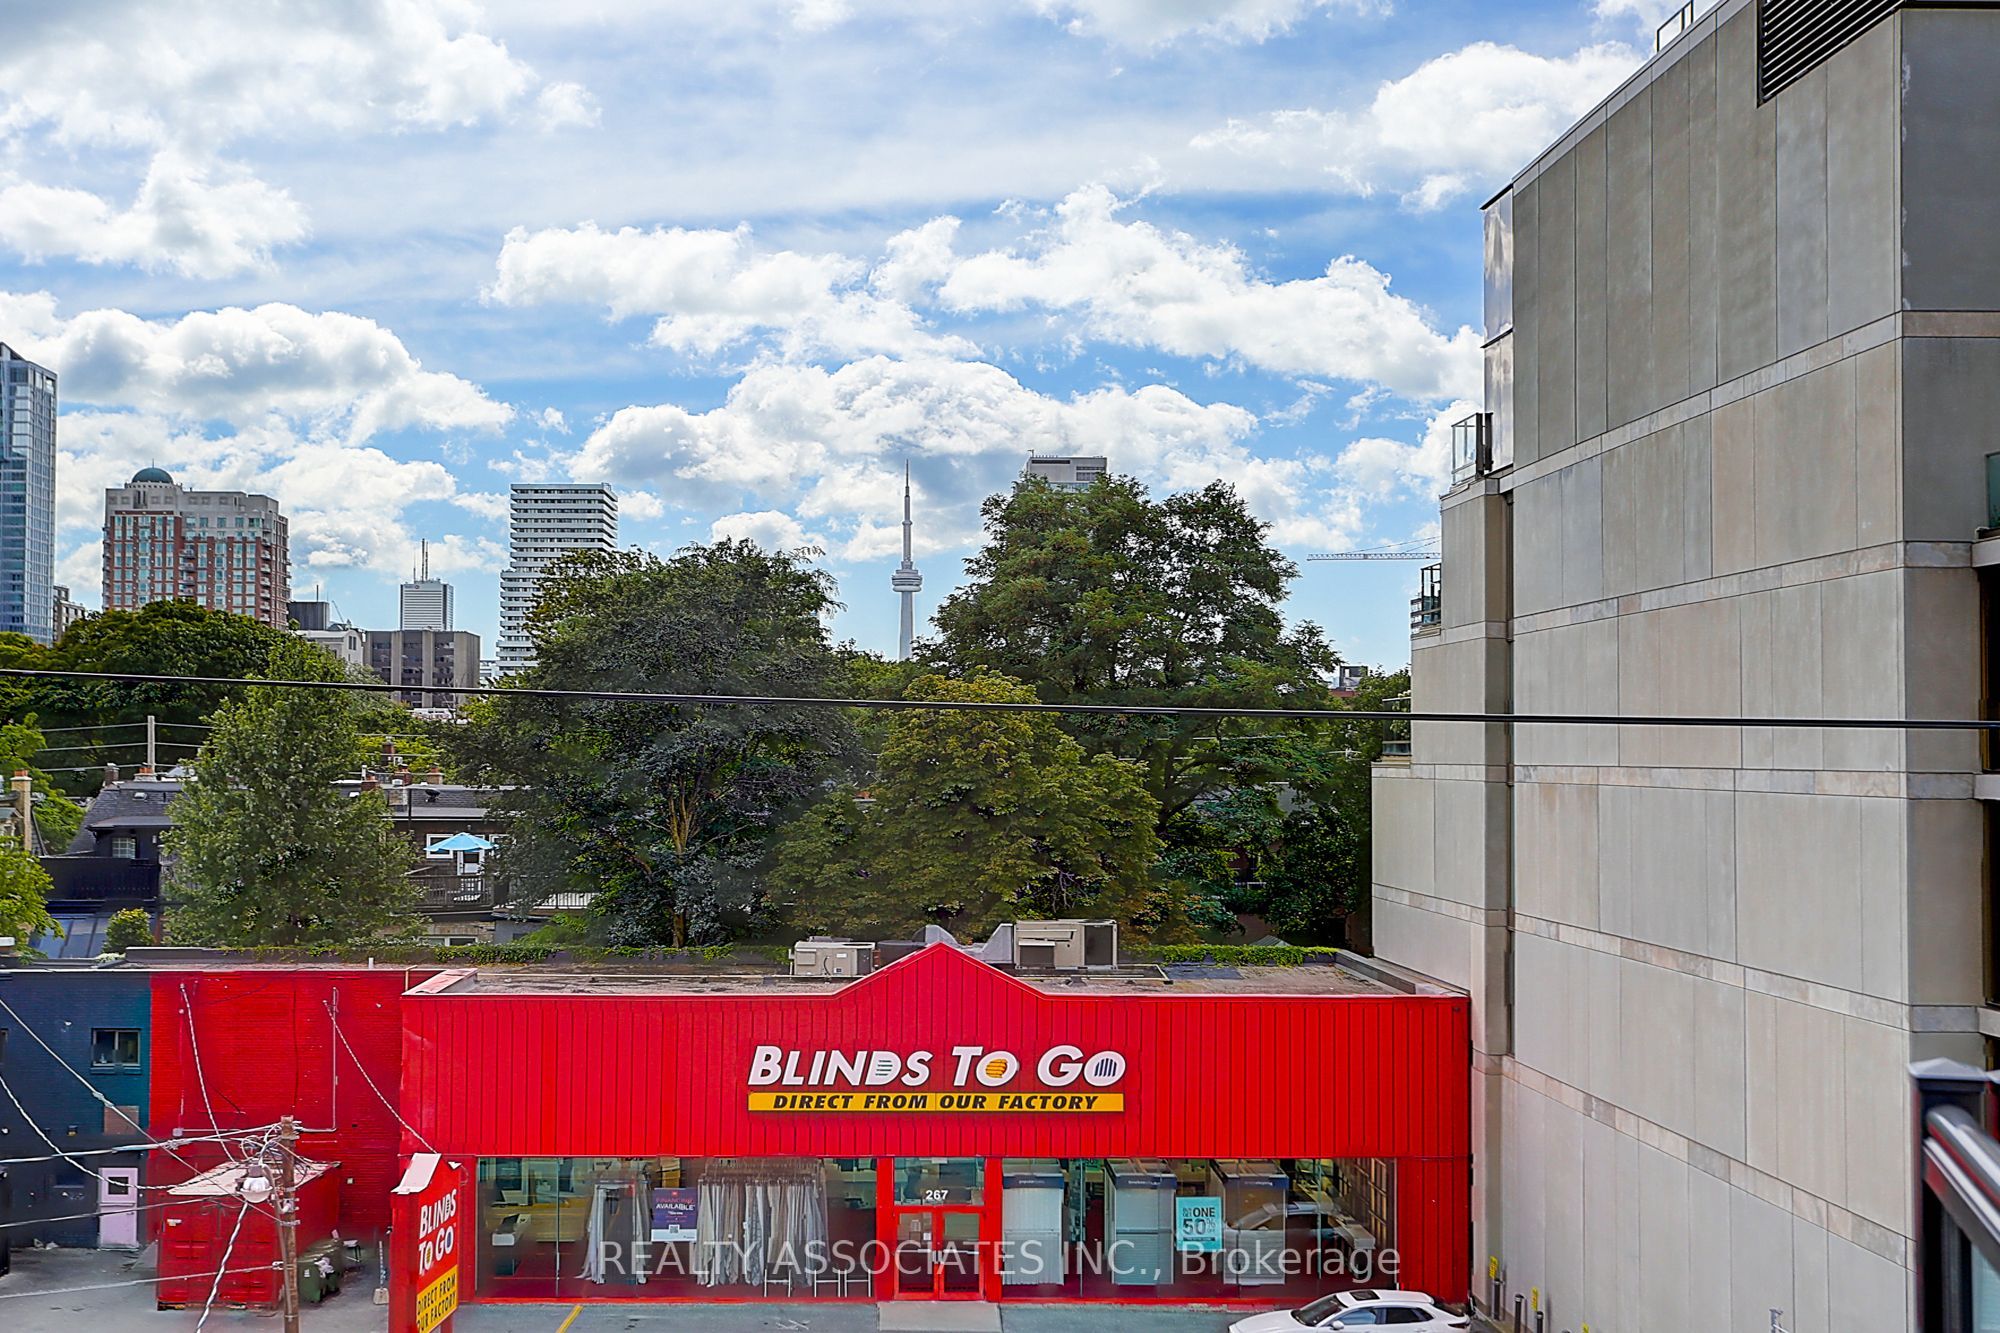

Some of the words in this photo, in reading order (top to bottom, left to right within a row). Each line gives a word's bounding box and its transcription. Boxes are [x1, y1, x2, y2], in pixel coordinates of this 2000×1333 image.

[748, 1045, 934, 1087] BLINDS
[952, 1046, 1019, 1087] TO
[1037, 1045, 1126, 1087] GO
[773, 1095, 853, 1109] DIRECT
[864, 1095, 928, 1109] FROM
[939, 1095, 987, 1109] OUR
[998, 1095, 1098, 1109] FACTORY
[925, 1189, 949, 1200] 267
[1192, 1207, 1216, 1218] ONE
[419, 1188, 457, 1240] BLINDS
[418, 1240, 434, 1276] TO
[435, 1226, 454, 1262] GO
[417, 1286, 438, 1315] DIRECT
[439, 1273, 456, 1298] FROM
[430, 1291, 456, 1324] FACTORY
